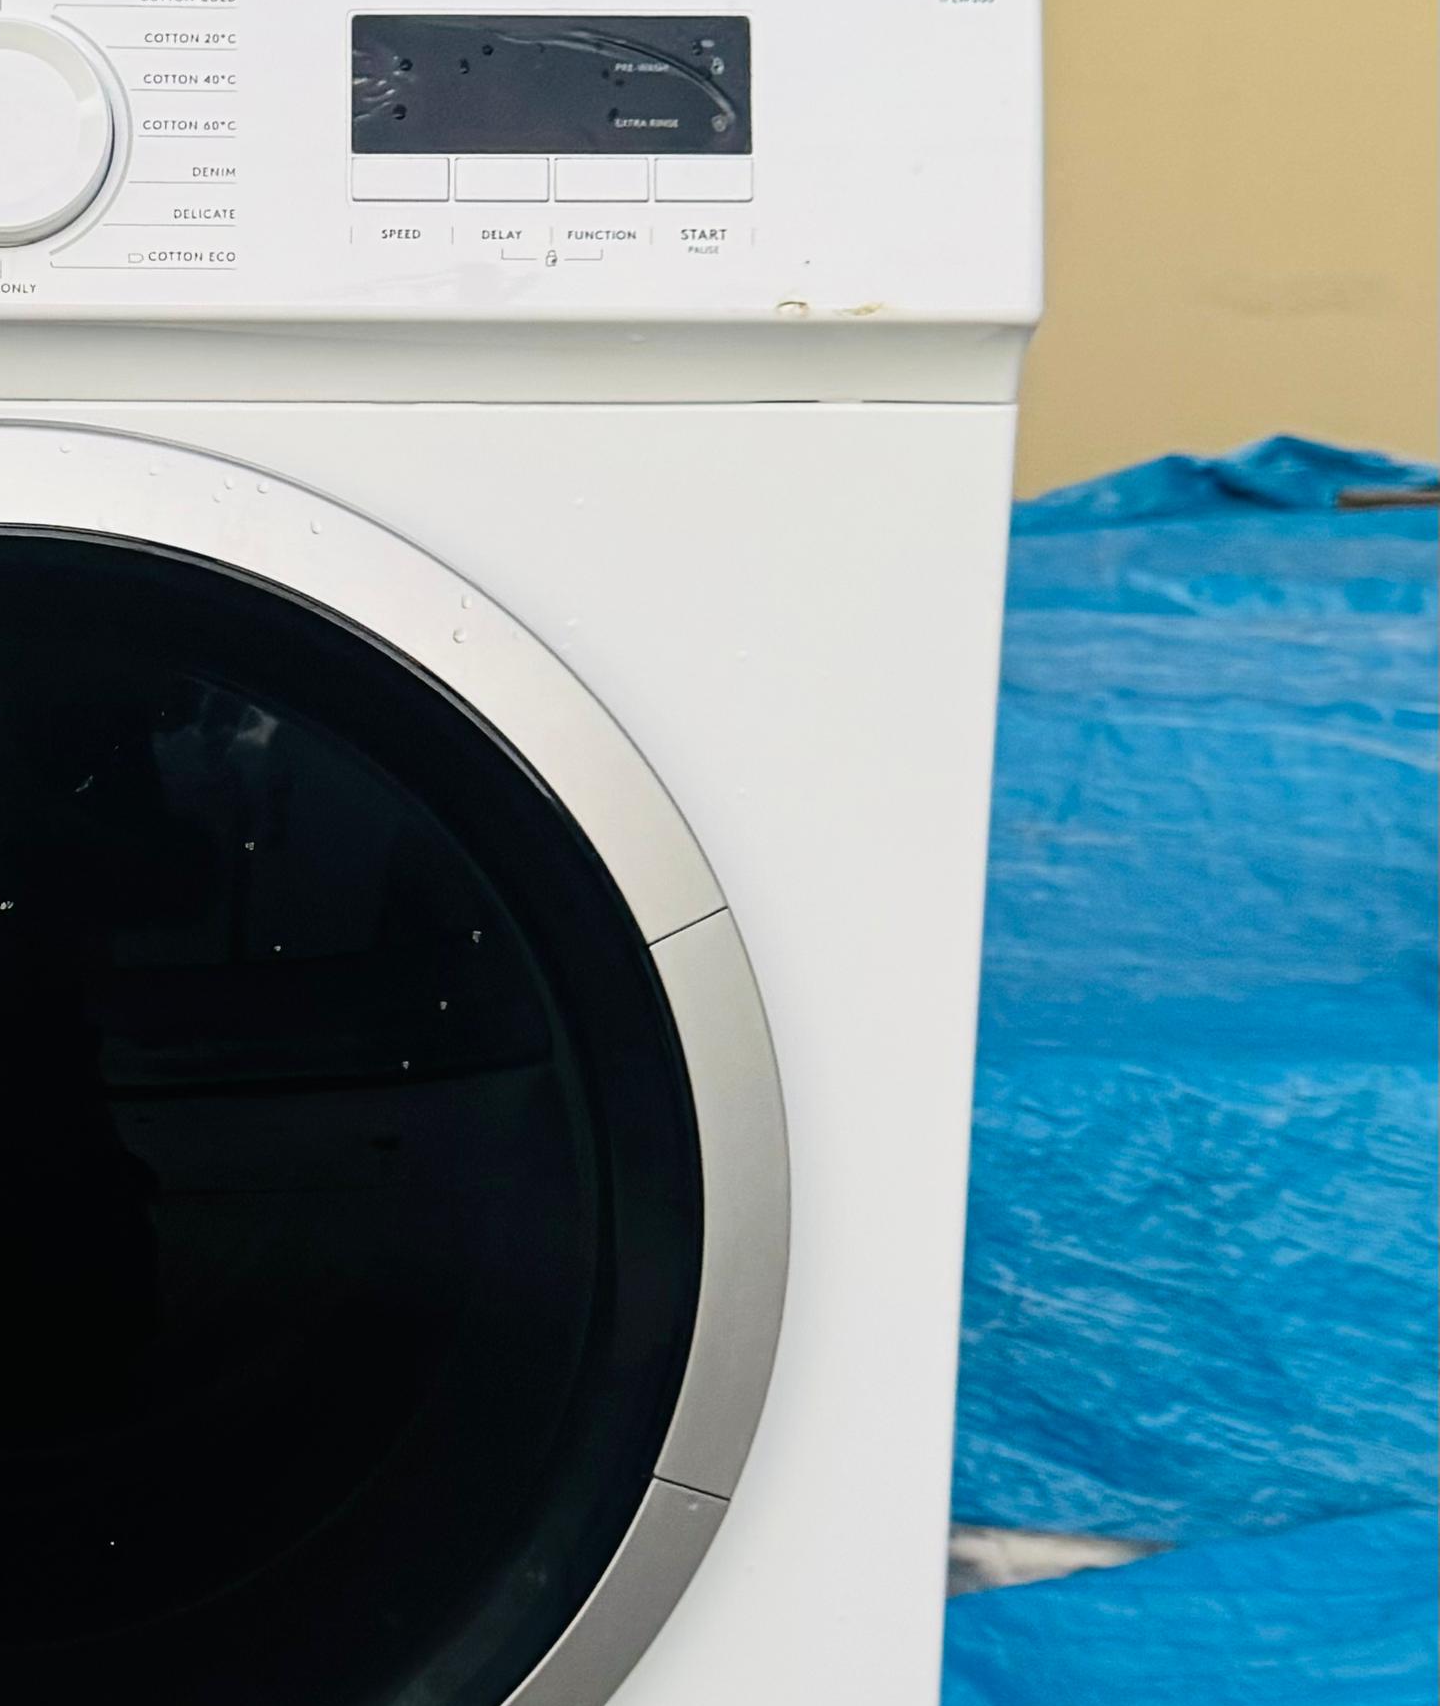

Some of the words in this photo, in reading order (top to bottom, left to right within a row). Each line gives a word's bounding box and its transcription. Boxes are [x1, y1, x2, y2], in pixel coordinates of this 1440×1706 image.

[144, 33, 200, 44] COTTON
[204, 33, 237, 44] 20°C
[143, 74, 199, 85] COTTON
[204, 74, 237, 85] 40°C
[142, 120, 198, 131] COTTON
[203, 120, 237, 131] 60°C
[192, 167, 236, 178] DENIM
[173, 209, 236, 220] DELICATE
[380, 229, 421, 240] SPEED
[481, 229, 522, 240] DELAY
[567, 229, 637, 241] FUNCTION
[680, 229, 728, 241] START
[687, 245, 720, 255] PAUSE
[148, 251, 203, 263] COTTON
[208, 251, 237, 262] ECO
[0, 283, 37, 294] ONLY
